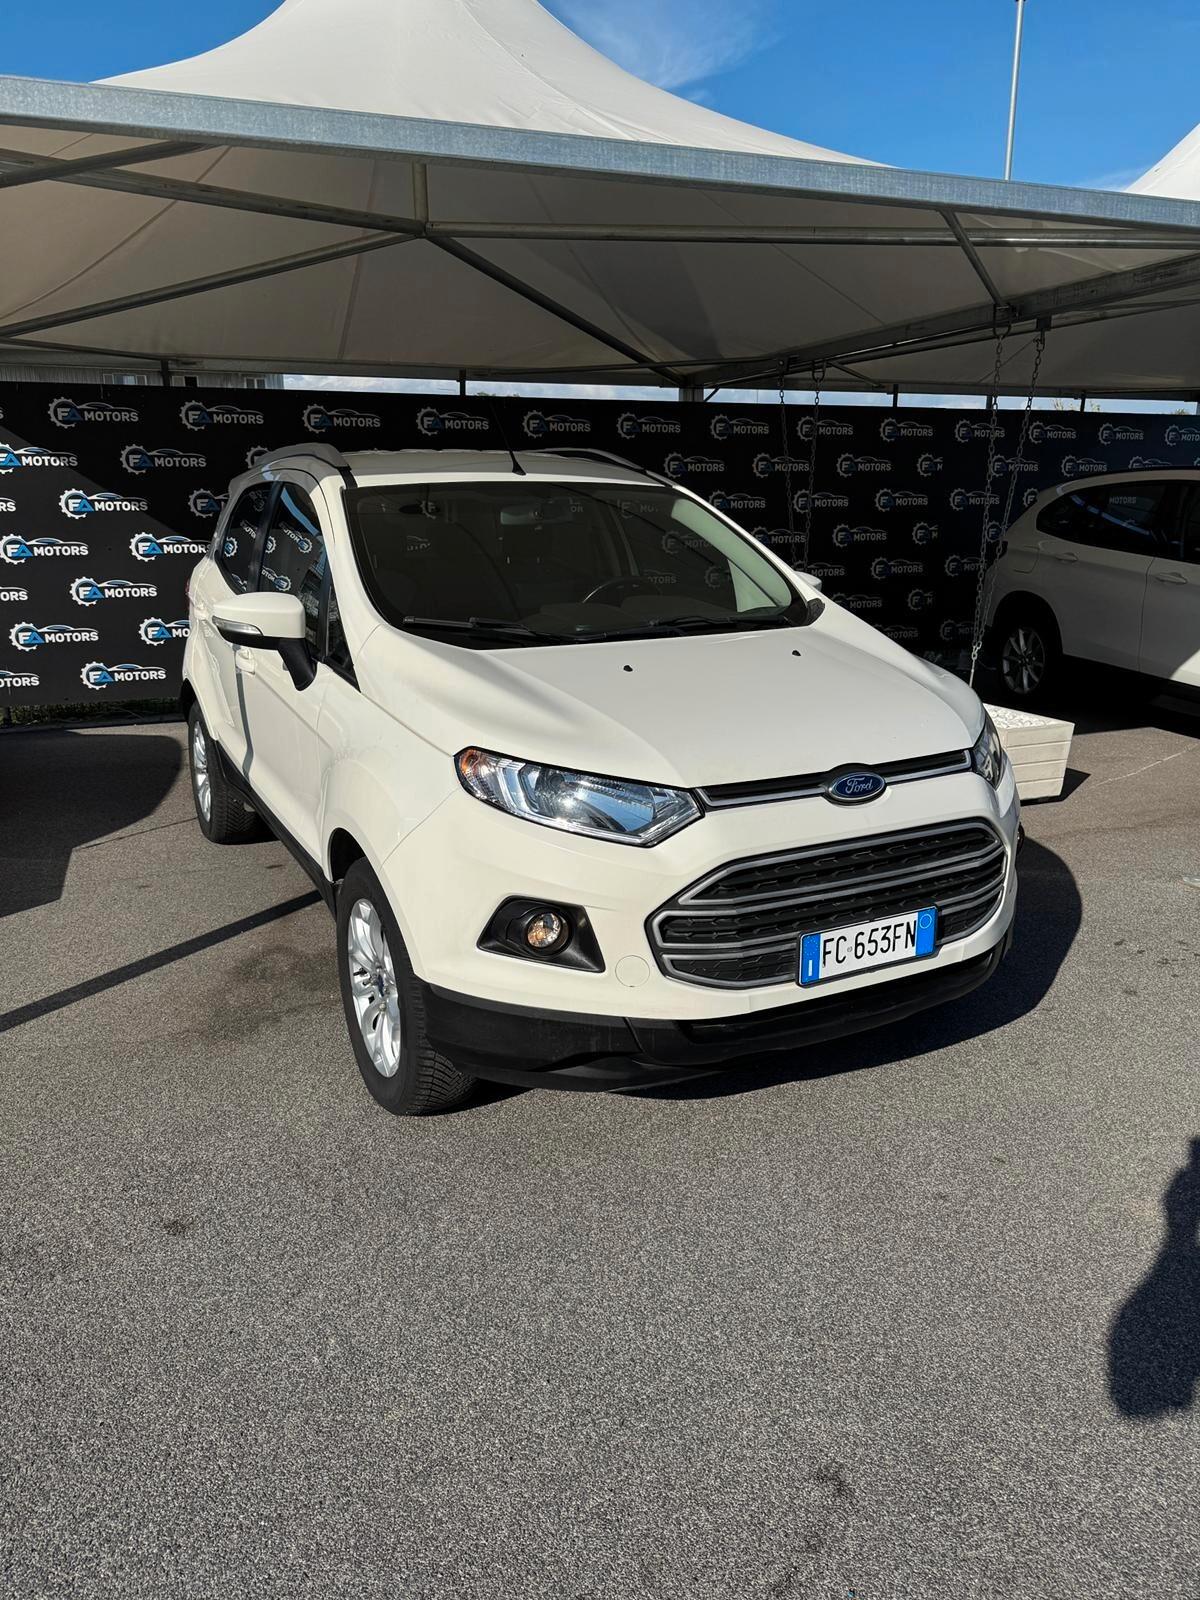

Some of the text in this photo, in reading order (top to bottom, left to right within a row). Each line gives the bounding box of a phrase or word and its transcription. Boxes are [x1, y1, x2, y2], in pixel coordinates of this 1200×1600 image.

[84, 411, 139, 421] MOTORS
[213, 414, 264, 424] MOTORS
[333, 417, 380, 428] MOTORS
[445, 420, 489, 430] MOTORS
[549, 422, 591, 432] MOTORS
[642, 423, 681, 433] MOTORS
[733, 425, 769, 434] MOTORS
[819, 427, 853, 436] MOTORS
[900, 428, 933, 437] MOTORS
[1047, 431, 1076, 439] MOTORS
[1116, 432, 1144, 440] MOTORS
[1181, 433, 1200, 441] MOTO
[22, 456, 79, 466] MOTORS
[155, 457, 207, 468] MOTORS
[687, 463, 725, 473] MOTORS
[858, 463, 891, 472] MOTORS
[1079, 464, 1107, 472] MOTORS
[731, 500, 766, 509] MOTORS
[815, 499, 848, 507] MOTORS
[896, 497, 928, 505] MOTORS
[1109, 496, 1136, 504] MOTORS
[68, 499, 148, 512] FA MOTORS
[853, 532, 887, 541] MOTORS
[6, 544, 89, 557] FA MOTORS
[138, 542, 163, 556] FA
[811, 568, 845, 577] MOTORS
[891, 564, 923, 573] MOTORS
[0, 591, 29, 601] ORS
[78, 587, 157, 599] FA MOTORS
[850, 600, 882, 608] MOTORS
[18, 631, 99, 645] FA MOTORS
[147, 627, 172, 640] FA
[88, 670, 166, 684] FA MOTORS
[845, 777, 873, 794] Ford
[822, 935, 848, 967] FC
[854, 920, 917, 960] 653FN
